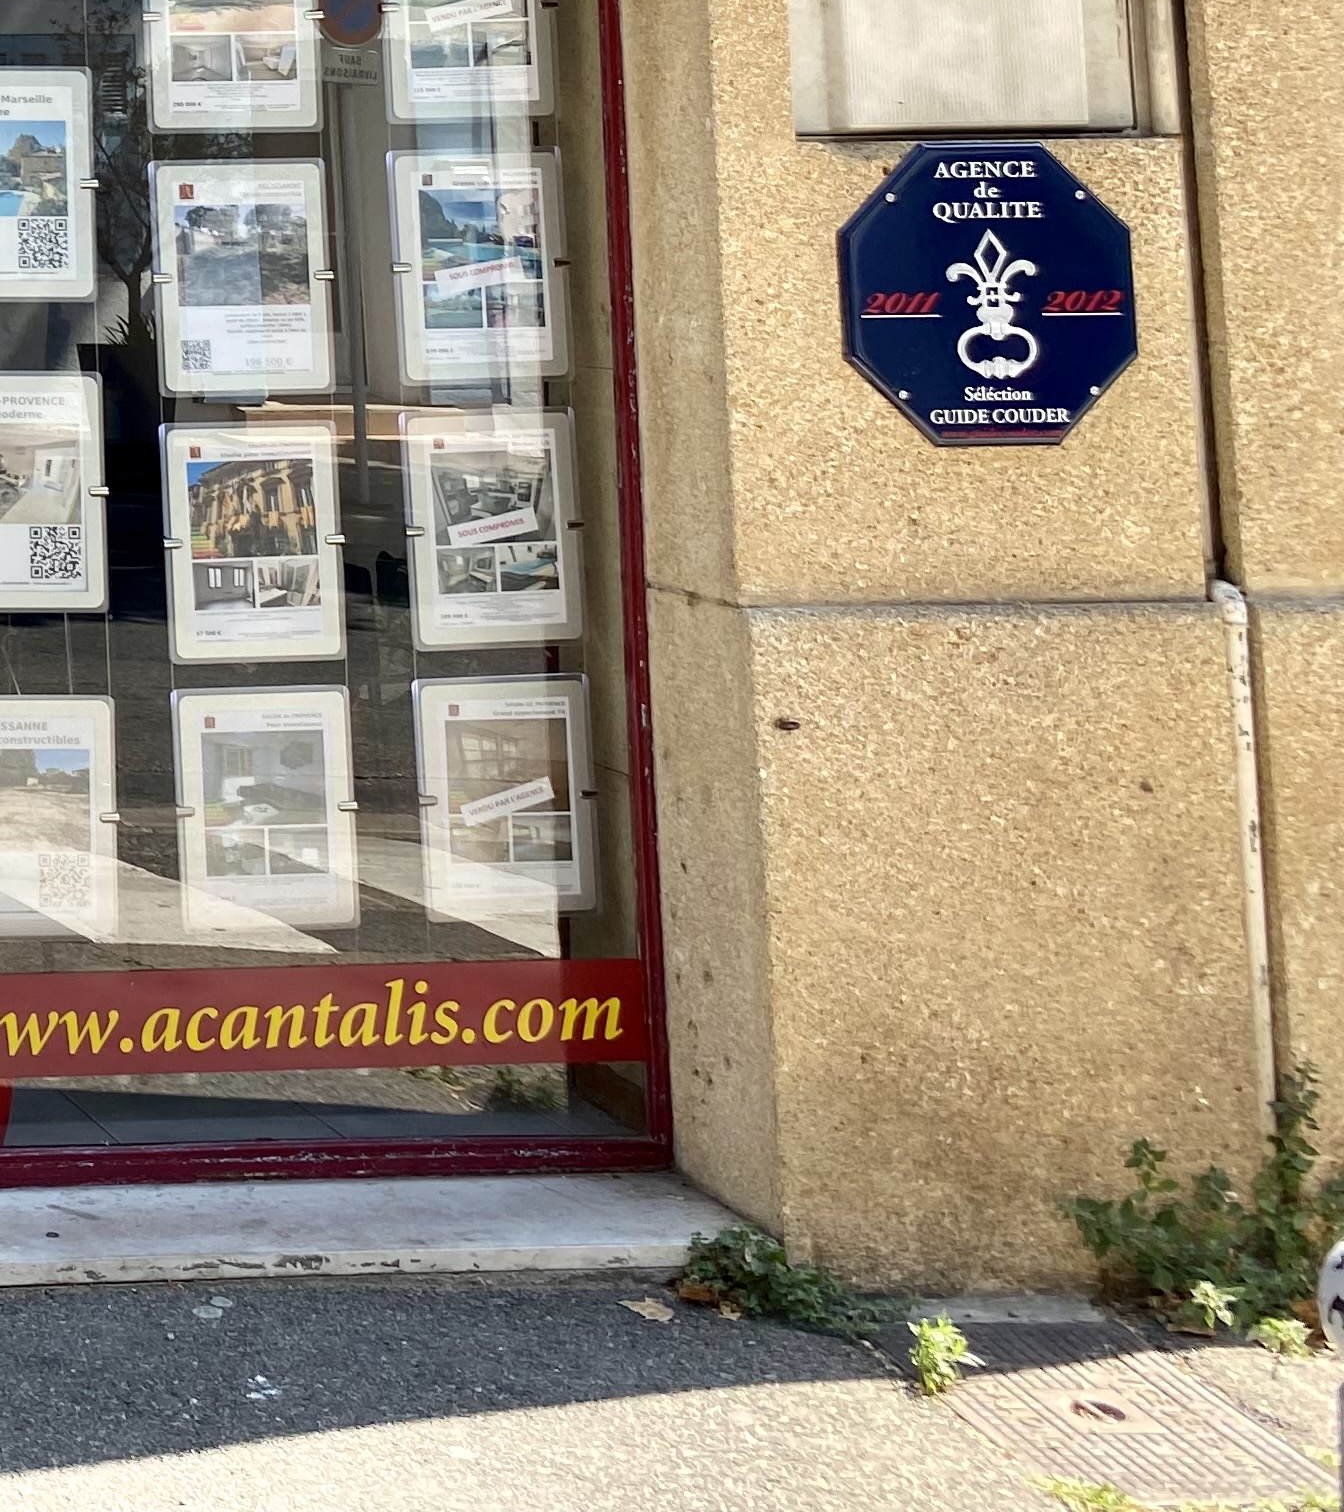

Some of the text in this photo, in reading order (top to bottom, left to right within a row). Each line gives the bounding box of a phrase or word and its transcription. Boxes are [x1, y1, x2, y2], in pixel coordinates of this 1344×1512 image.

[0, 93, 53, 104] Marseille
[934, 161, 1036, 179] AGENCE
[973, 181, 1000, 198] de
[932, 201, 1043, 224] QUALITE
[863, 291, 941, 314] 2011
[1043, 289, 1124, 312] 2012
[929, 408, 1070, 425] GUIDE COUDER
[494, 798, 510, 809] PAR
